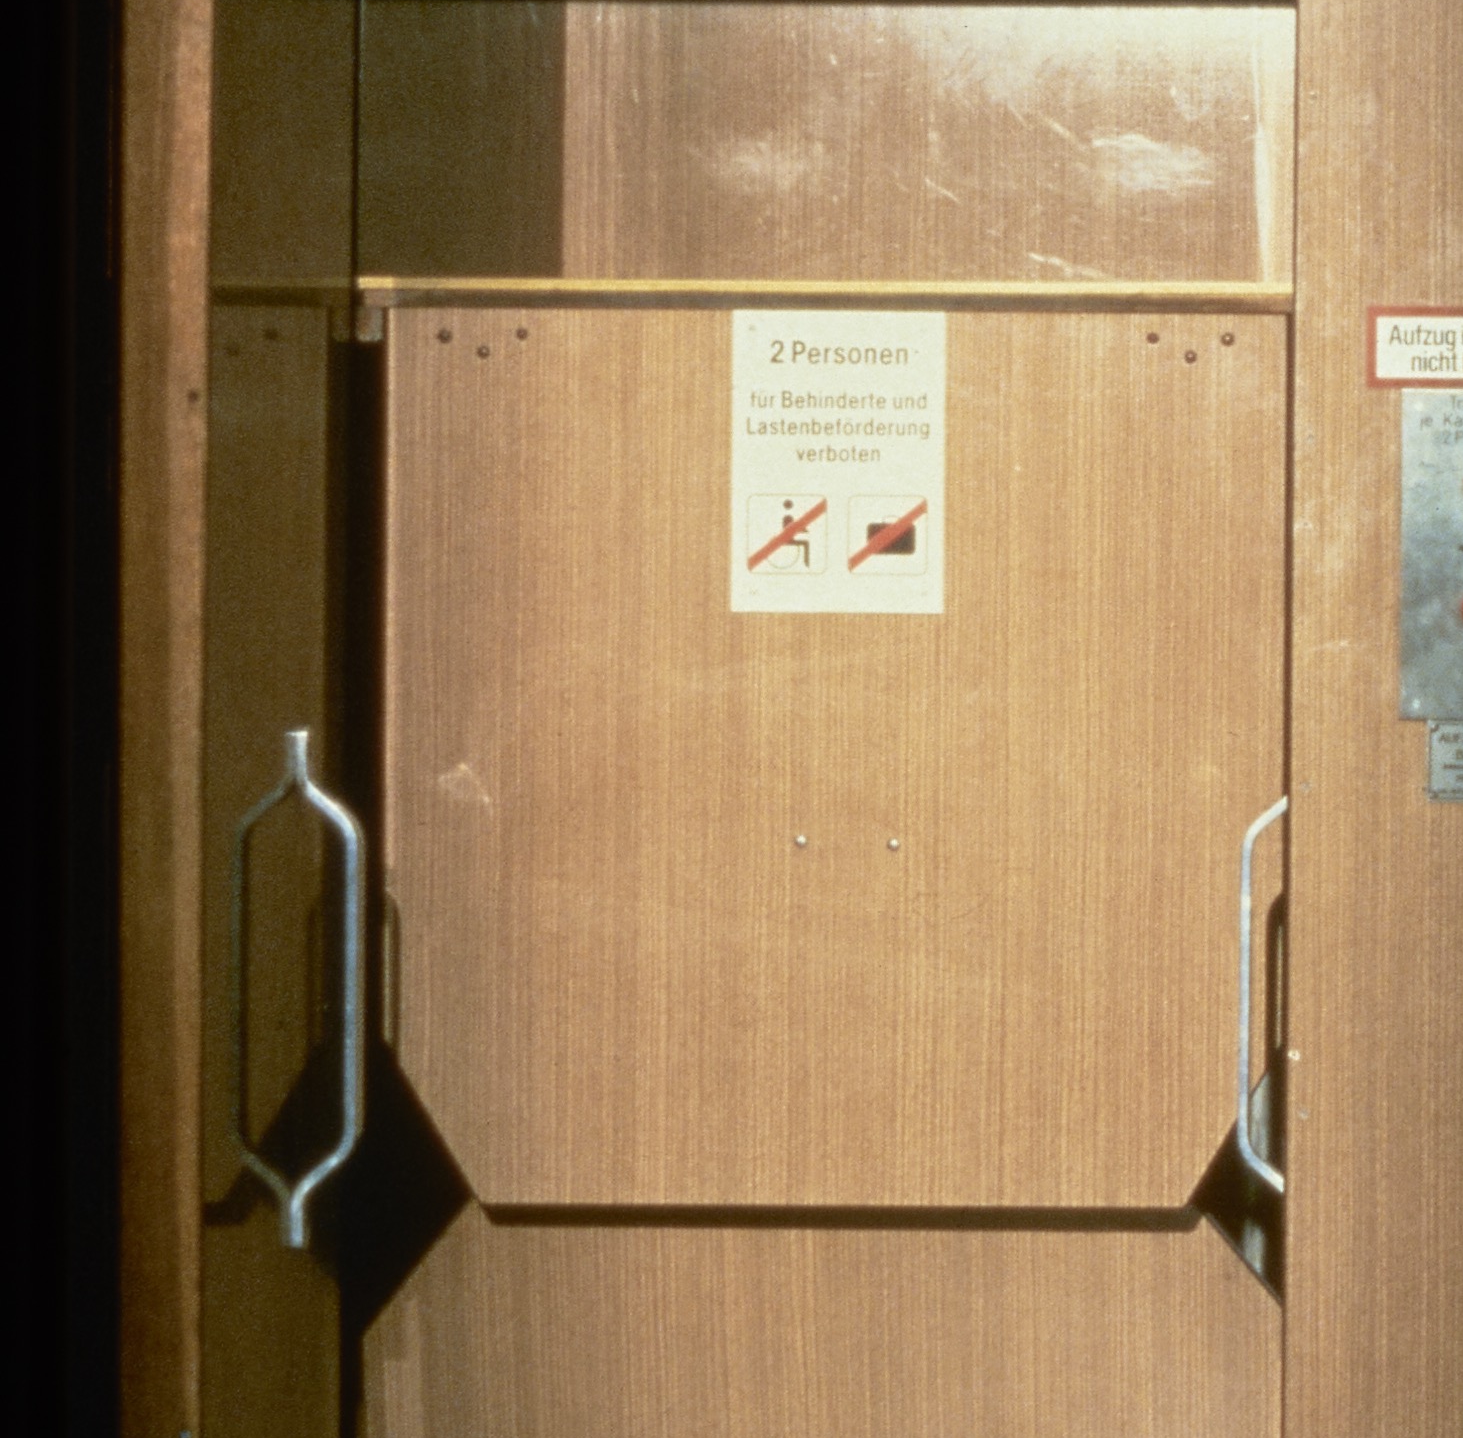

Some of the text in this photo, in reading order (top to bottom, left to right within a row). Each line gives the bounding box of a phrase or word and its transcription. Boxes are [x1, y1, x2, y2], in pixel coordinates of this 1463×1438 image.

[1389, 324, 1456, 351] Aufzug
[769, 340, 909, 365] 2 Personen
[1410, 351, 1457, 373] nicht
[750, 389, 928, 410] für Behinderte und
[746, 416, 931, 440] Lastenbeförderung
[795, 445, 882, 463] verboten
